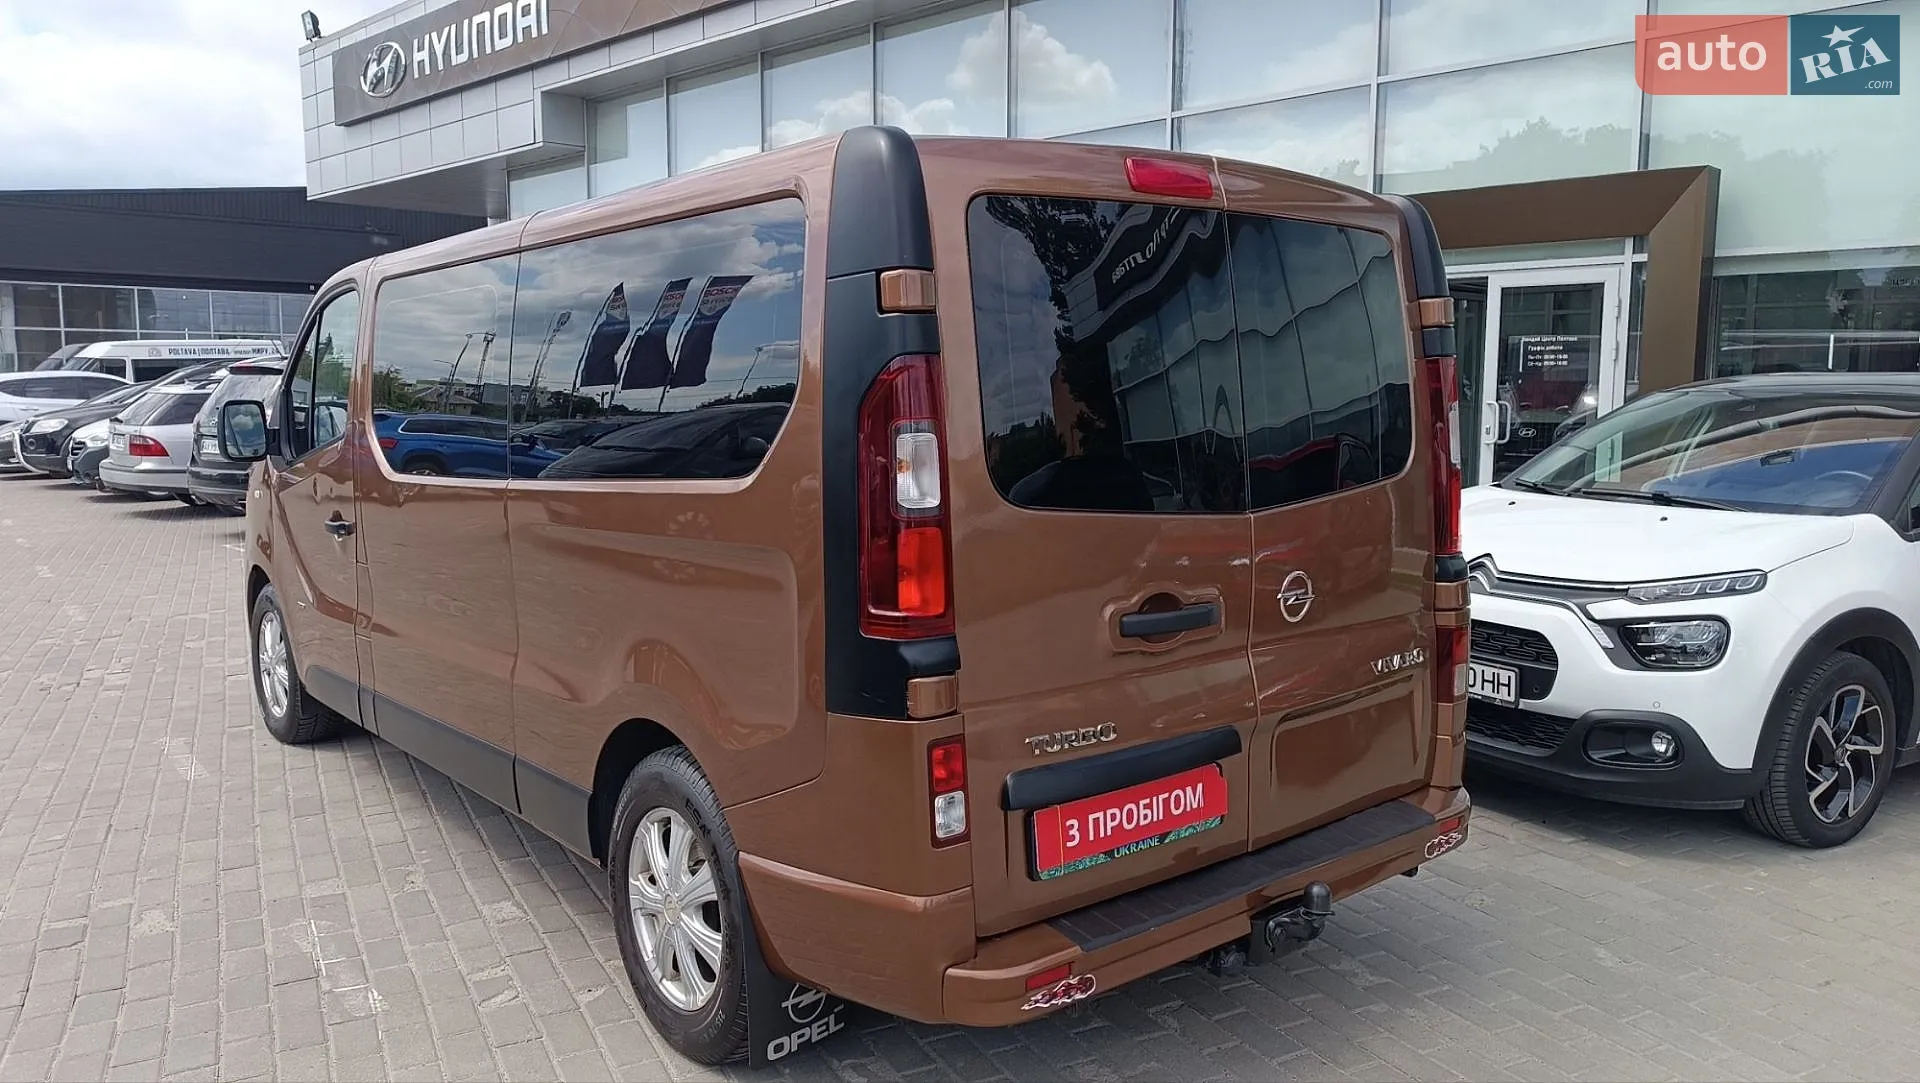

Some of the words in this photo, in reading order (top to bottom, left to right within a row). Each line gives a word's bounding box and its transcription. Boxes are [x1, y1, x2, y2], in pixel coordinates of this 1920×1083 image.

[412, 0, 549, 79] HYUNDAI
[1025, 721, 1118, 755] TURBO
[1088, 782, 1205, 841] ПРОБІГОМ
[1114, 836, 1161, 859] UKRAINE
[766, 1013, 845, 1061] OPEL
